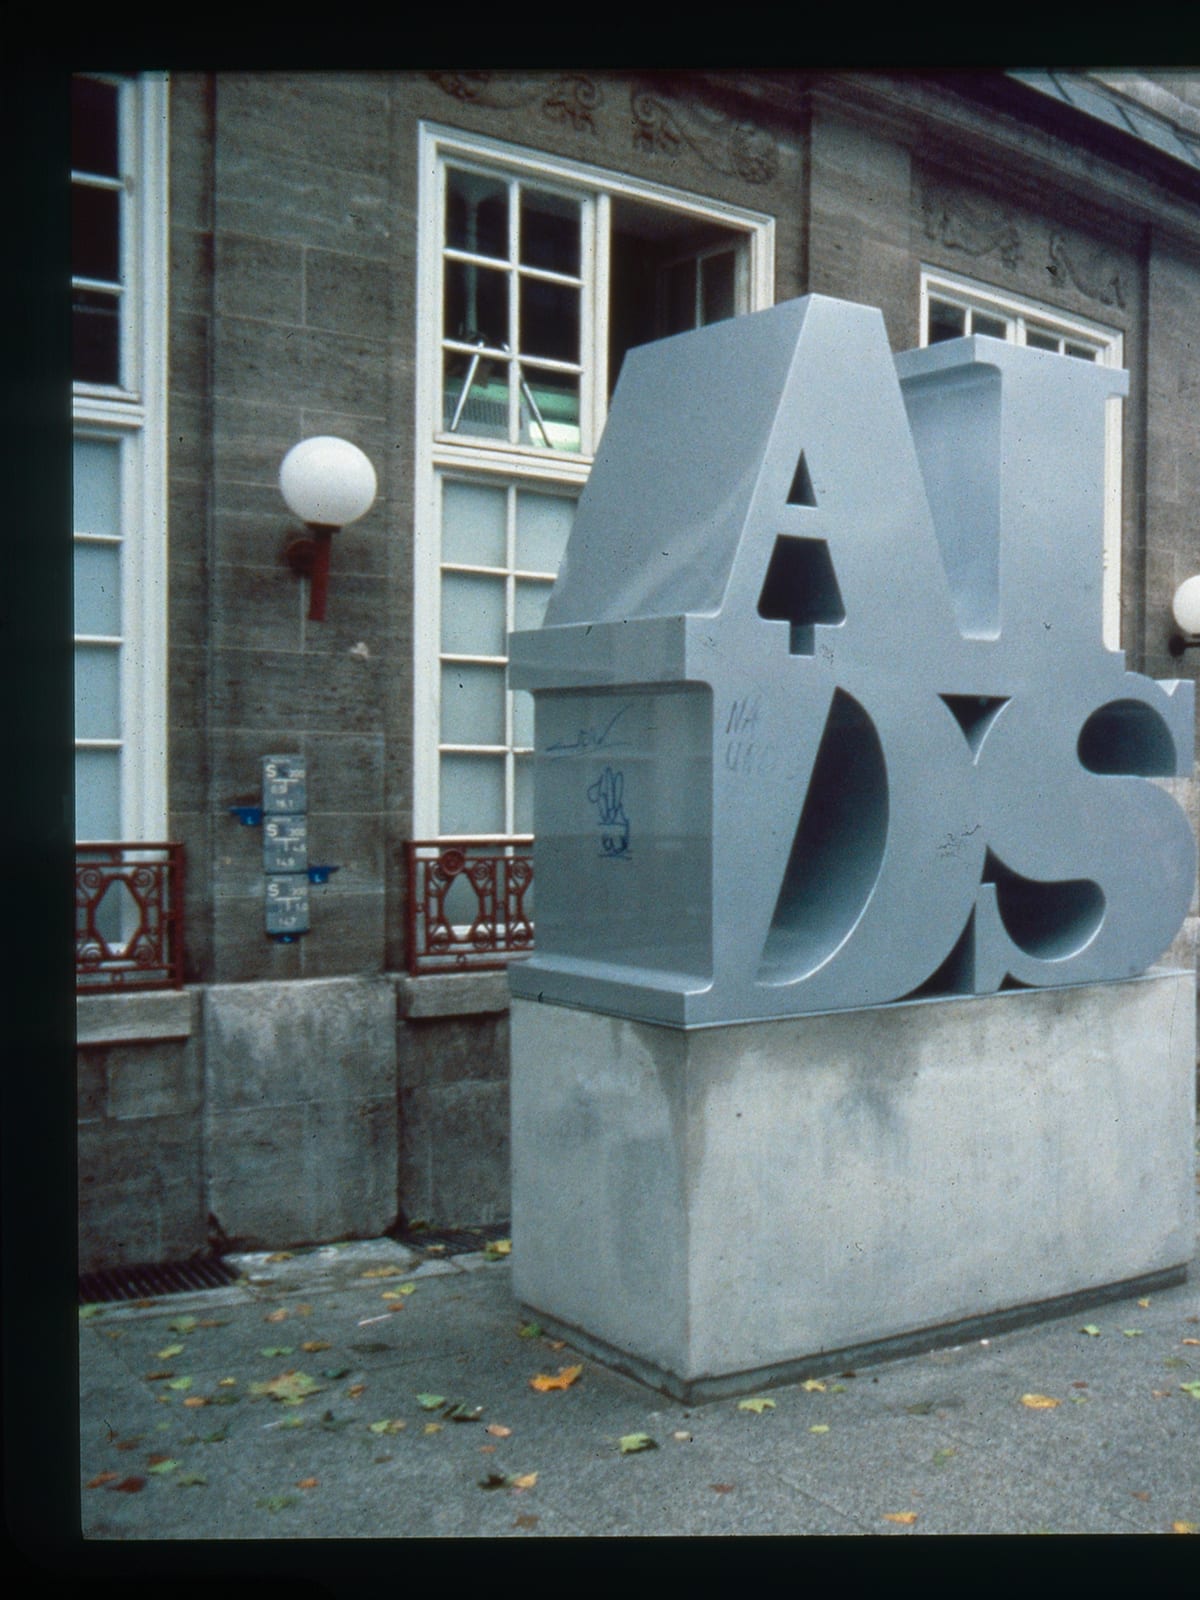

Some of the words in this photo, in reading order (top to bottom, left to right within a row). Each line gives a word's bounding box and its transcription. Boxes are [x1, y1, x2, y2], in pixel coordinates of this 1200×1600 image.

[265, 764, 277, 778] S
[266, 823, 278, 838] S
[267, 883, 280, 898] S
